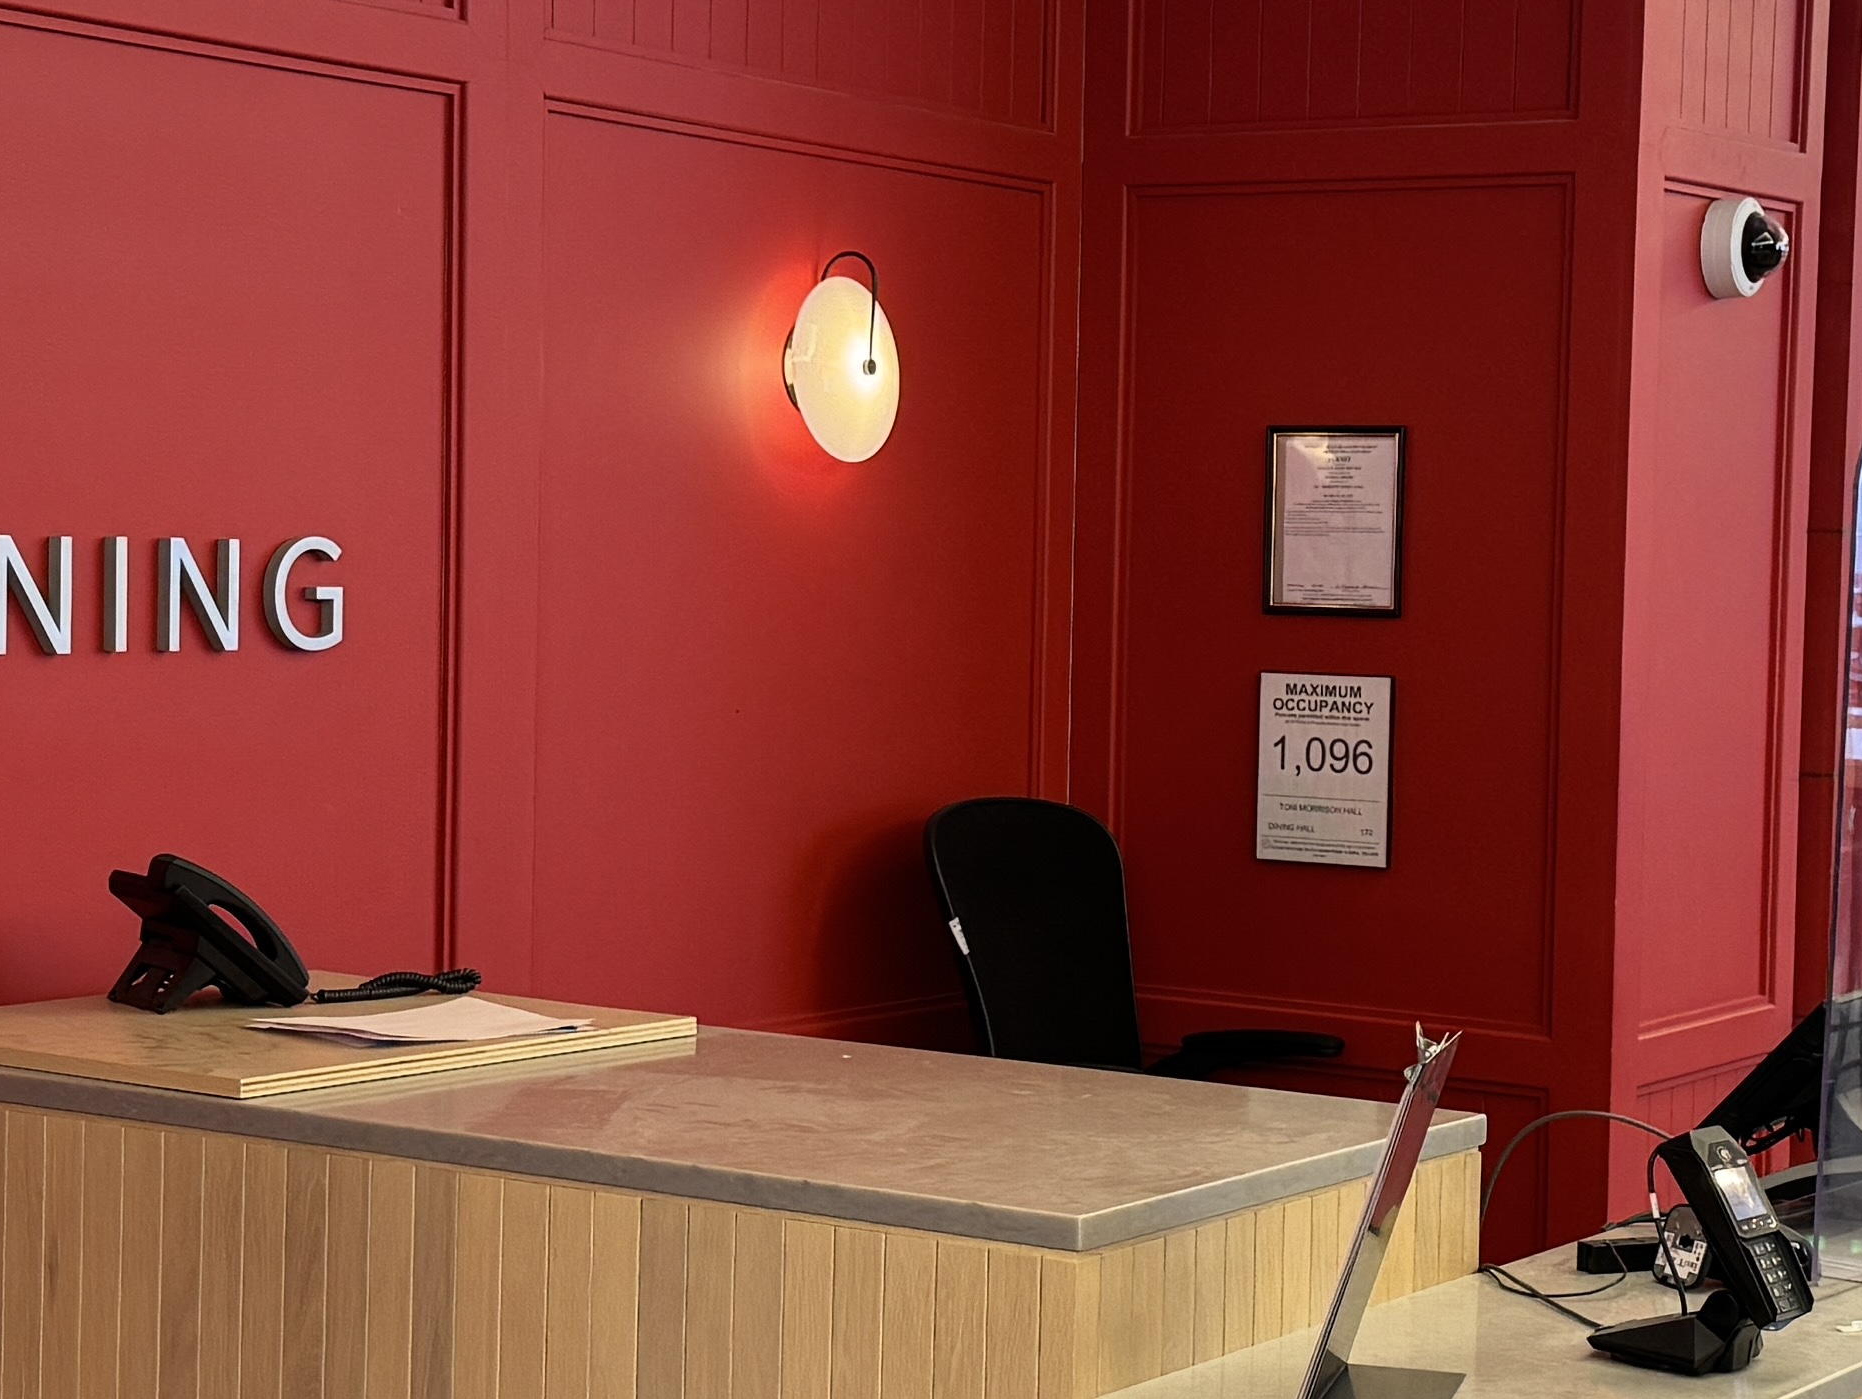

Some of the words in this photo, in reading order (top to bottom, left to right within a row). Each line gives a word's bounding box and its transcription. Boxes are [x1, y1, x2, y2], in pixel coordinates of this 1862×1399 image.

[1285, 683, 1362, 698] MAXIMUM
[1273, 697, 1374, 715] OCCUPANCY
[1273, 735, 1373, 777] 1,096
